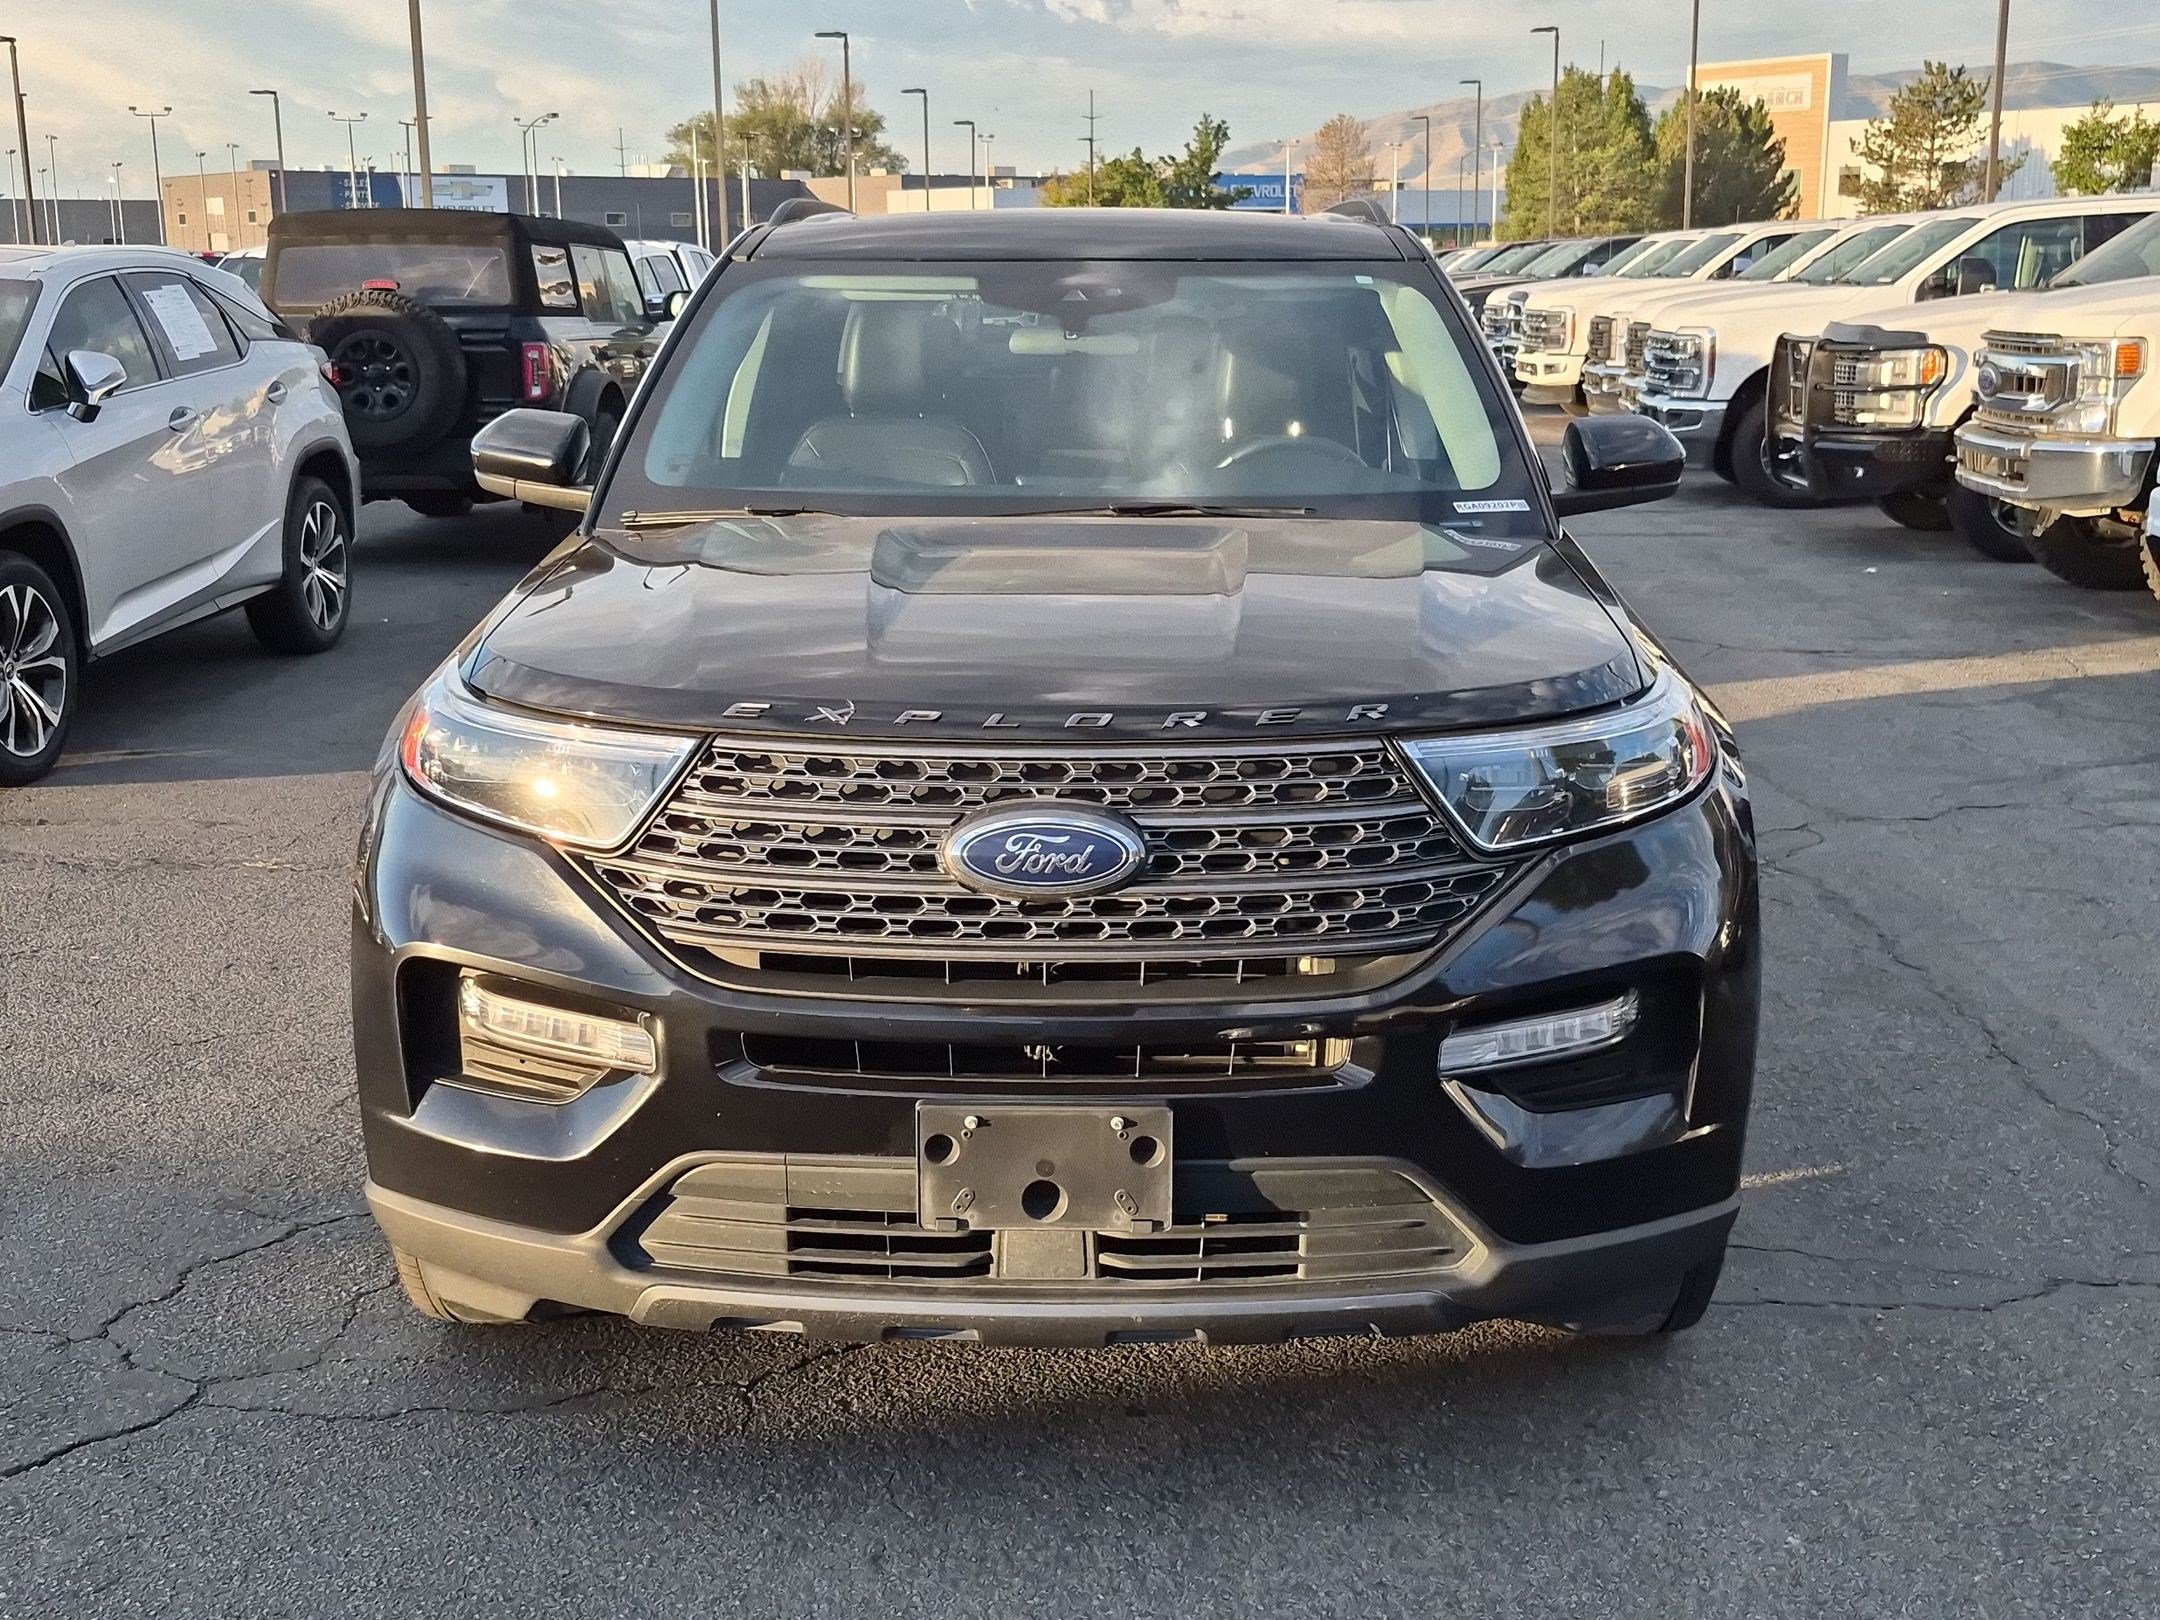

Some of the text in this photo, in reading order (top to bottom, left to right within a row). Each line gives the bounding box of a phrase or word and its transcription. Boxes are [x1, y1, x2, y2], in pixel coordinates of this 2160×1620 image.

[1756, 90, 1804, 106] ANCH
[722, 699, 1390, 729] EXPLORER
[994, 832, 1096, 875] Ford
